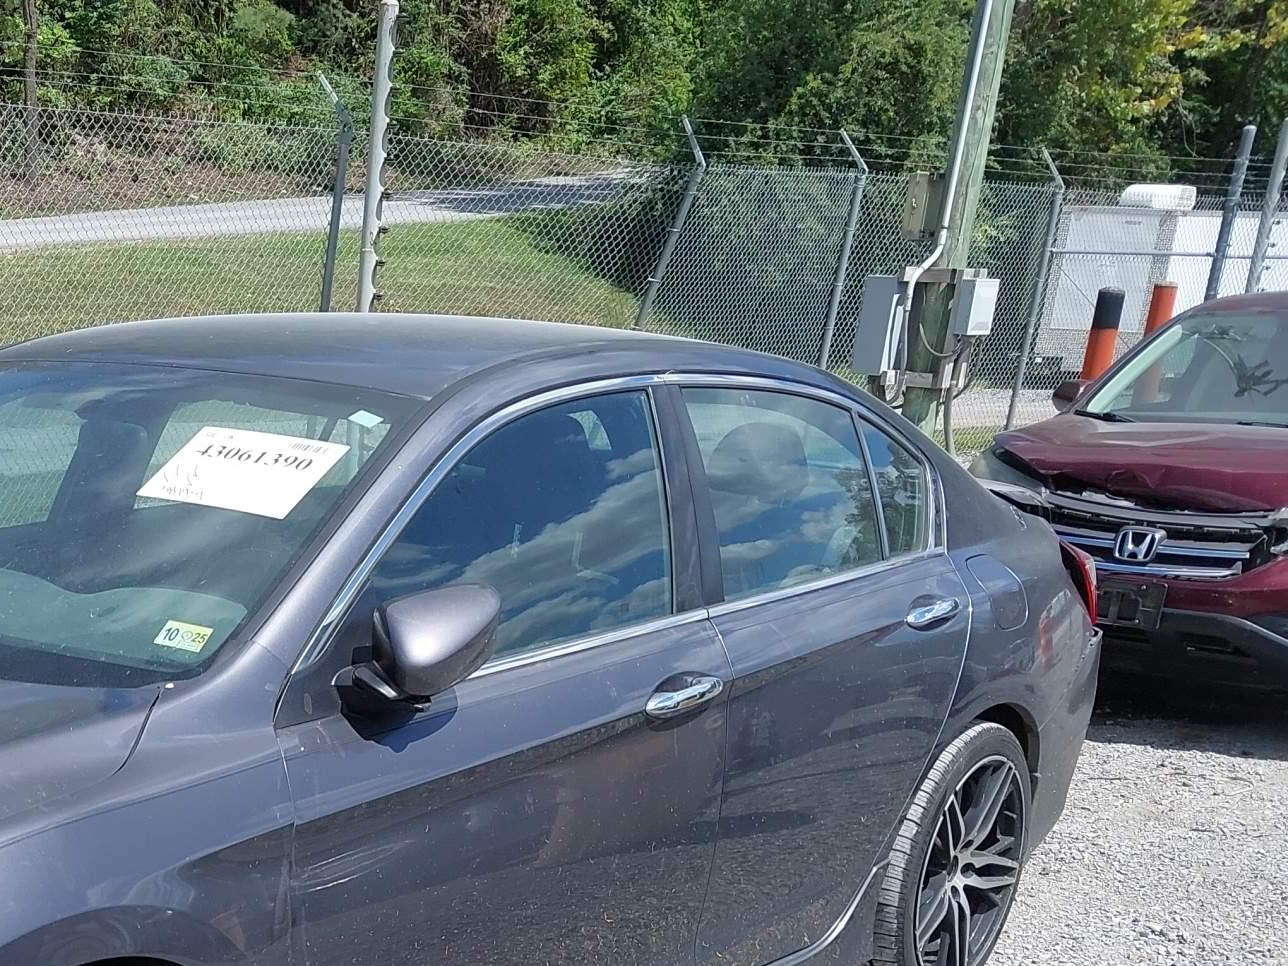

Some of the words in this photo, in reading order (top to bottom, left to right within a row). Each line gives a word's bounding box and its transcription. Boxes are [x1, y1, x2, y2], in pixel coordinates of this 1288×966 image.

[193, 444, 312, 470] 43061390
[162, 627, 180, 642] 10
[192, 632, 209, 644] 25
